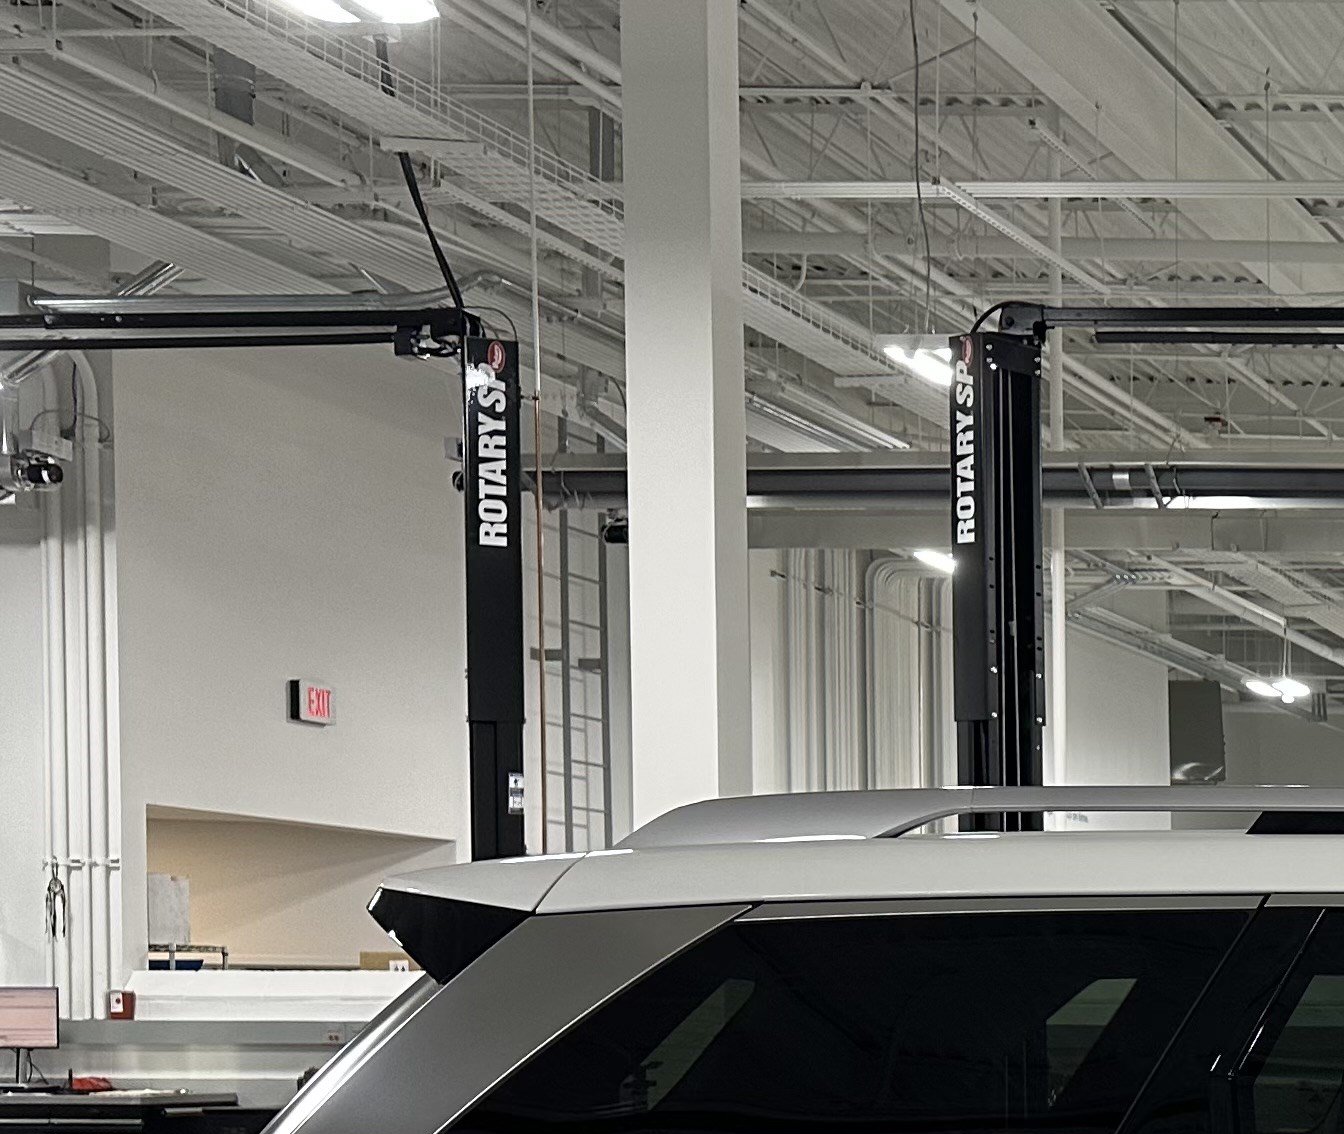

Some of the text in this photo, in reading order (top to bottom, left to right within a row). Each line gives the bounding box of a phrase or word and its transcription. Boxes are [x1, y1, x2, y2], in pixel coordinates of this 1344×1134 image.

[955, 360, 974, 408] SP
[478, 411, 508, 547] ROTARY
[956, 410, 976, 544] ROTARY
[307, 687, 331, 718] EXIT
